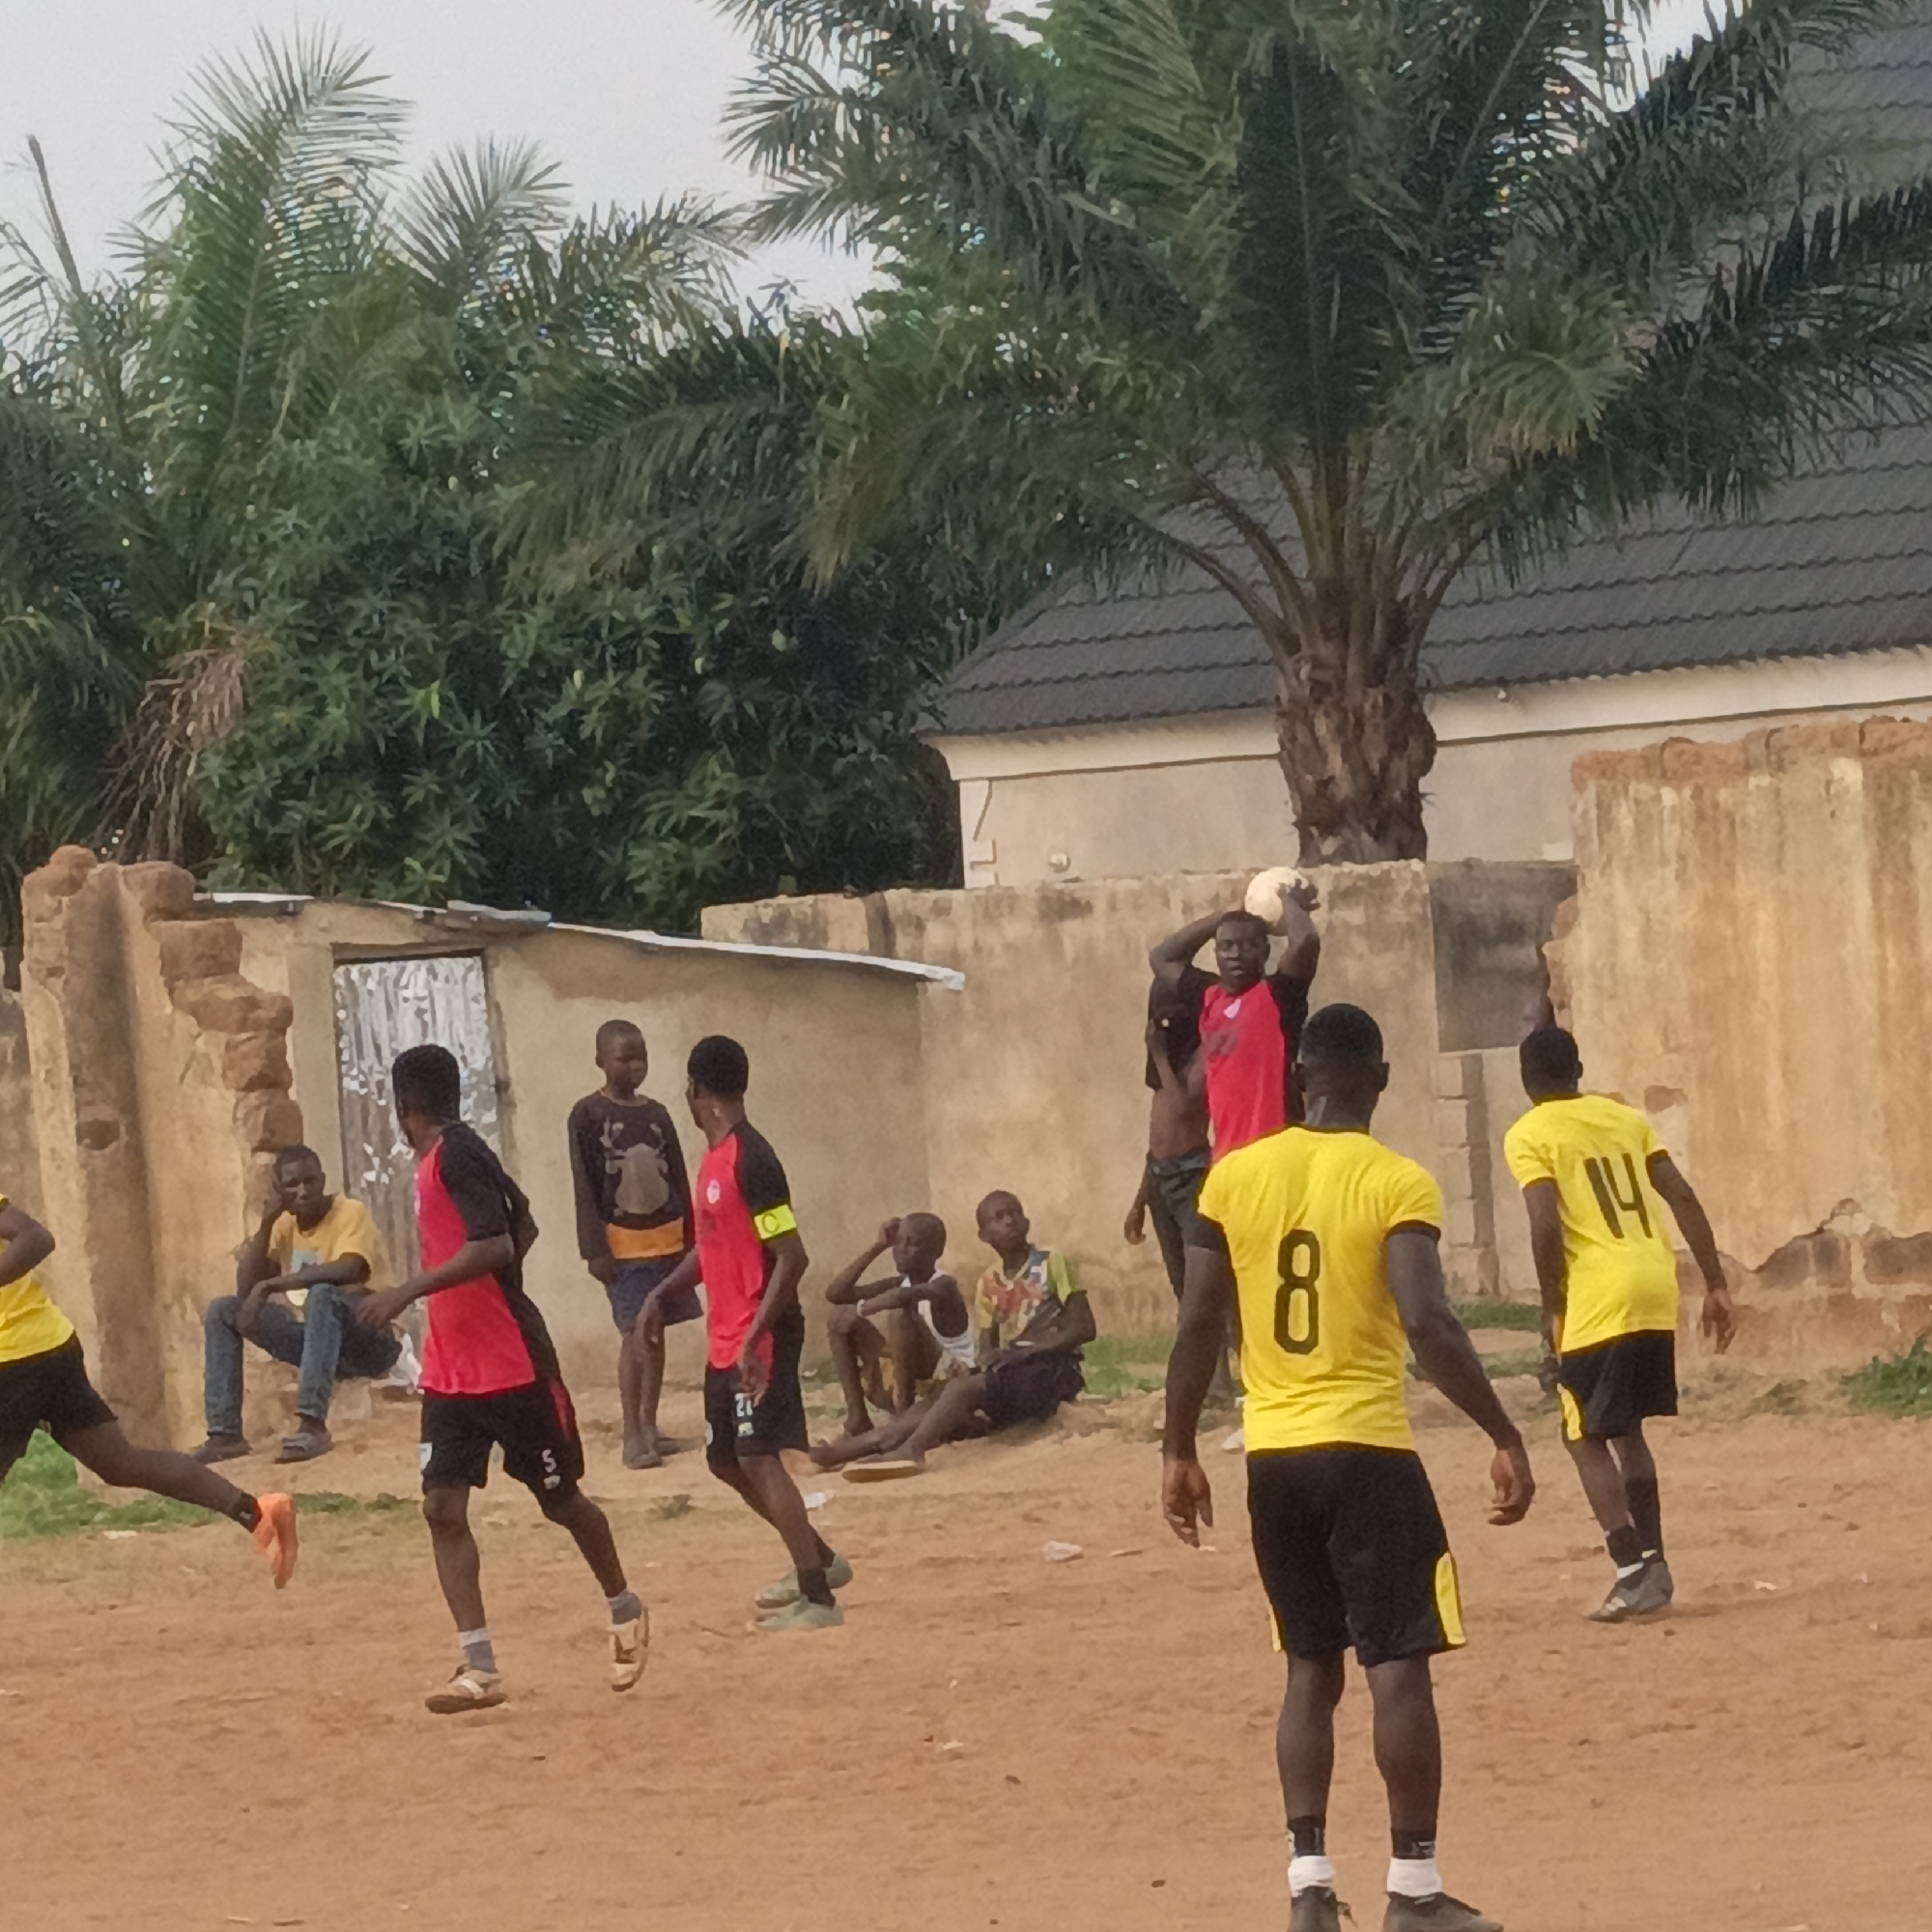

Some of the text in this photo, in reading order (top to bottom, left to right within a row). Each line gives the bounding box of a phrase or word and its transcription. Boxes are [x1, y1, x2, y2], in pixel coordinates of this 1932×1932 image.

[761, 1212, 780, 1234] C
[1583, 1152, 1653, 1239] 14
[1273, 1229, 1320, 1354] 8
